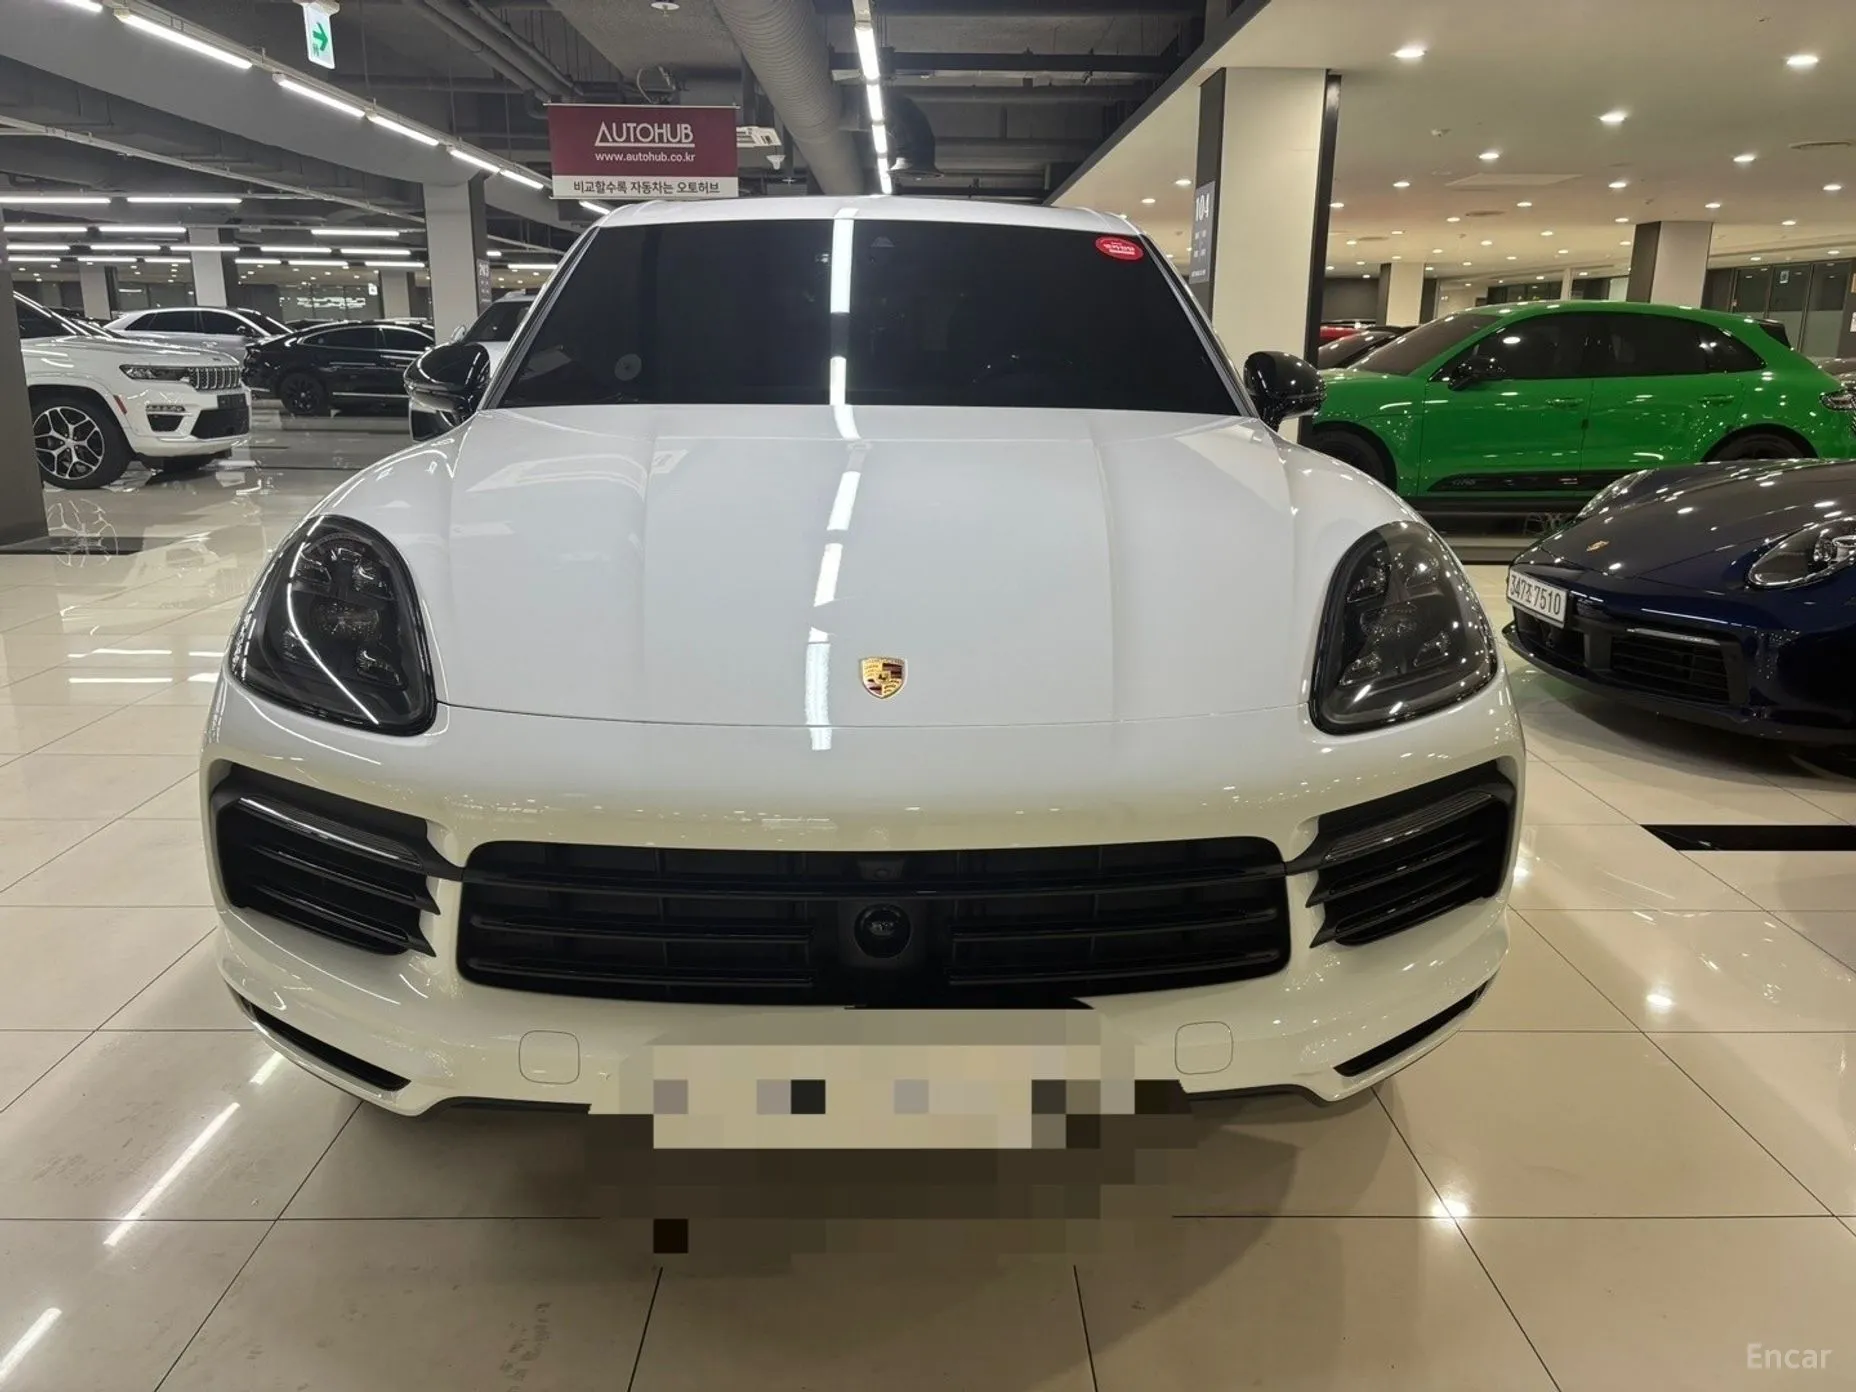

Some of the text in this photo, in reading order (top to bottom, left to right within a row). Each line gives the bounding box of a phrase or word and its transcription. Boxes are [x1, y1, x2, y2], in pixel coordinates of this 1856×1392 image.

[595, 121, 695, 147] AUTOHUB
[595, 151, 696, 162] www.autohub.co.kr
[573, 181, 720, 194] 비교할수록 자동차는 오토허브
